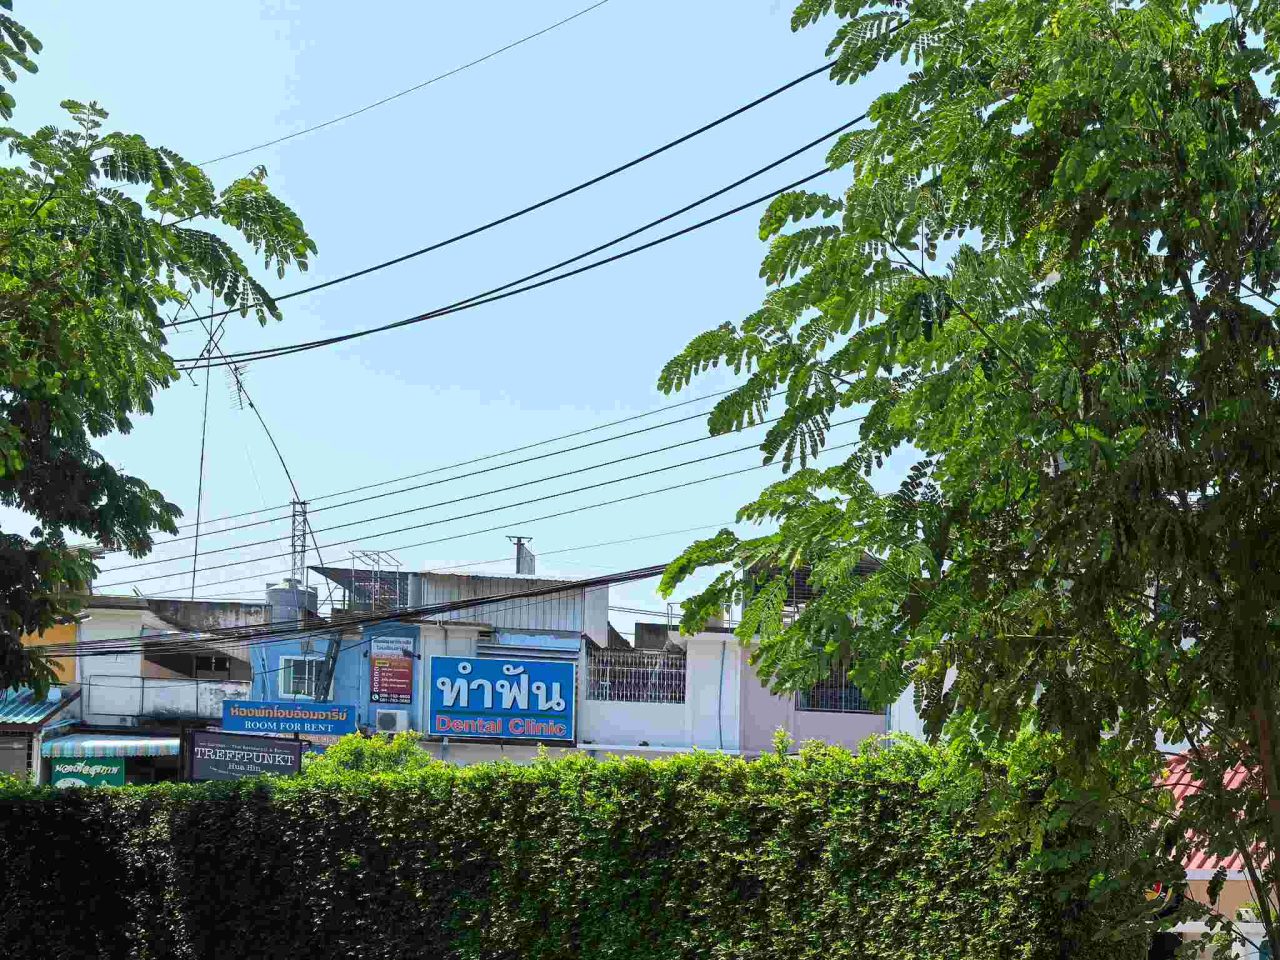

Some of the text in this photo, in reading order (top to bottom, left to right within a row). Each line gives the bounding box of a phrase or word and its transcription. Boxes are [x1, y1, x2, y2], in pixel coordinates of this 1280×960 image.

[436, 661, 566, 712] ทำฟัน
[245, 720, 334, 732] ROOM FOR RENT
[435, 715, 567, 736] Dental Clinic
[194, 747, 295, 766] TREFFPUNKT
[228, 763, 245, 771] Hua
